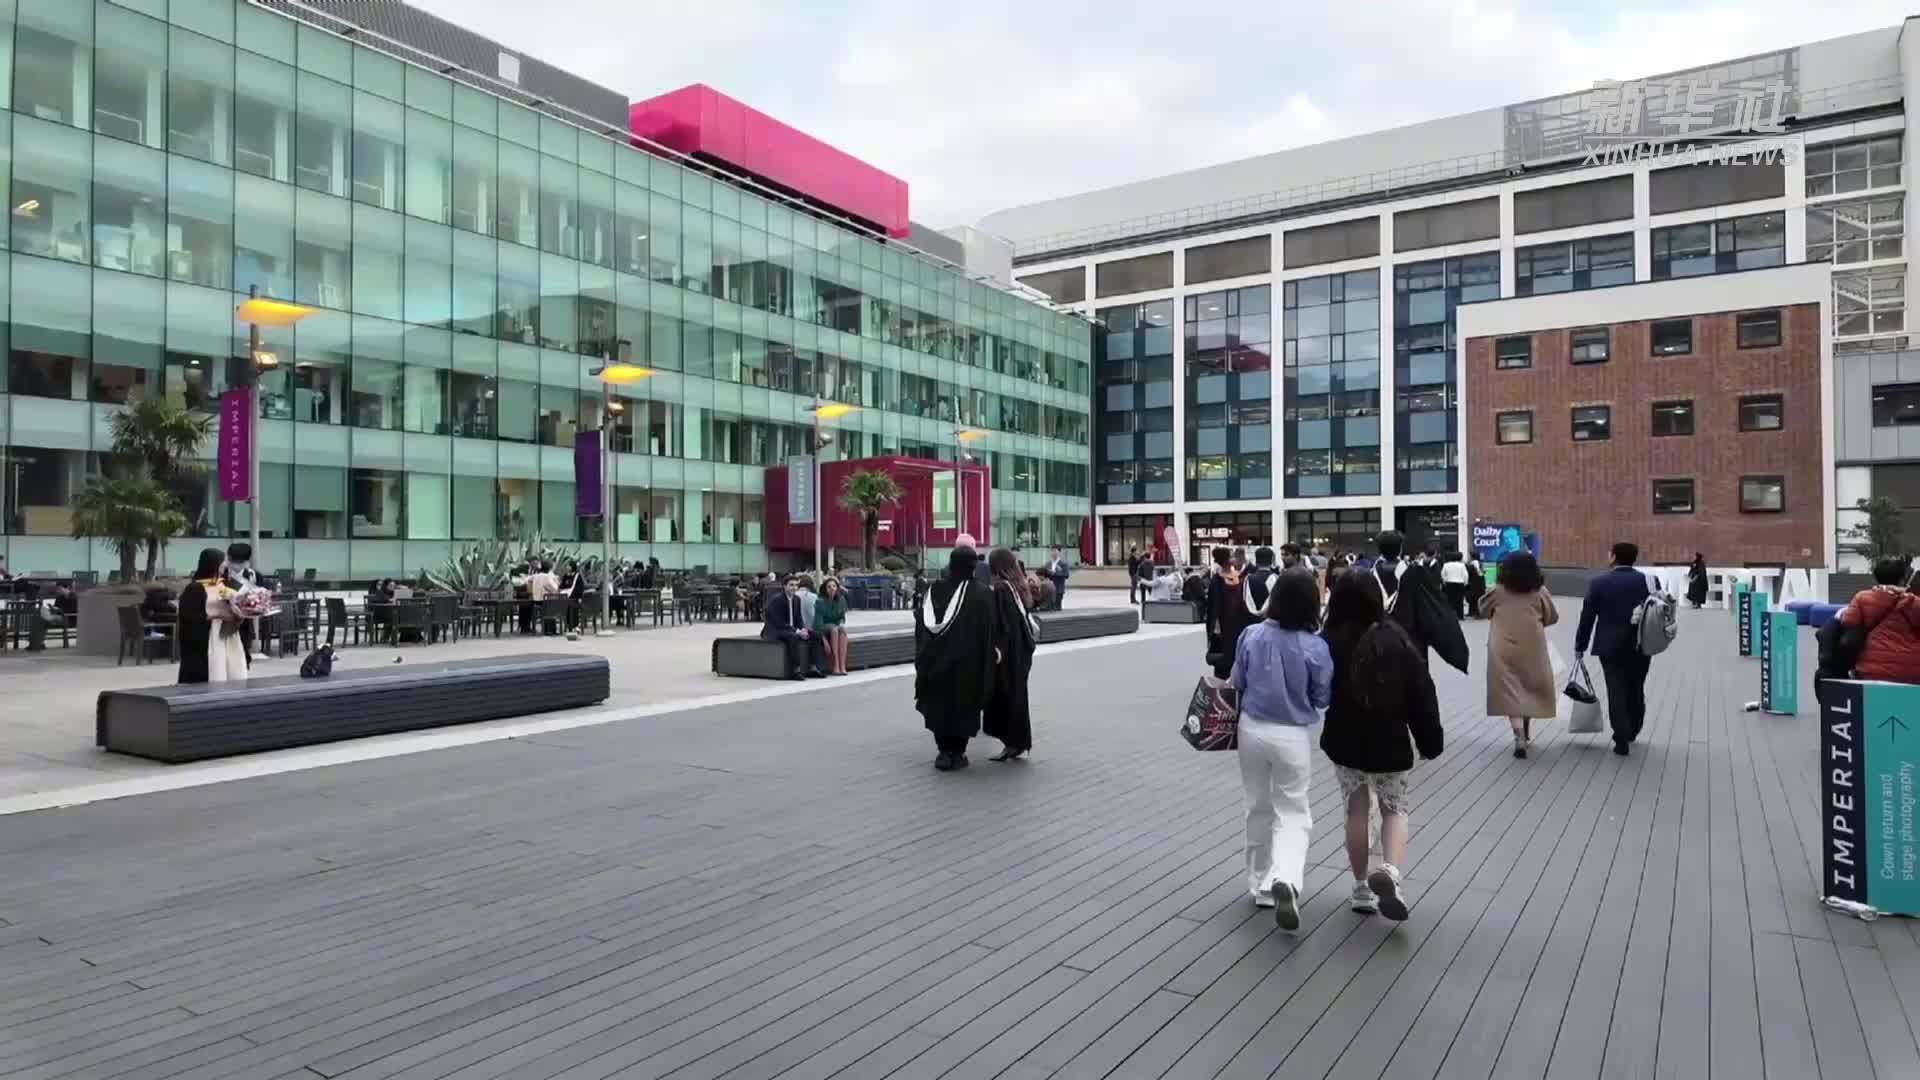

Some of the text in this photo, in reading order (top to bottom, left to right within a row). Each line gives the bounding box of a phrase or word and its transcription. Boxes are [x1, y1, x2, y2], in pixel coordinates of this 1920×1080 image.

[231, 399, 240, 492] IMPERIAL
[1473, 527, 1501, 538] Dalby
[1473, 537, 1500, 547] Court
[1742, 595, 1750, 652] IMPERIAL
[1831, 698, 1855, 889] IMPERIAL
[1880, 774, 1895, 880] Gown return and
[1898, 760, 1917, 881] stage photography
